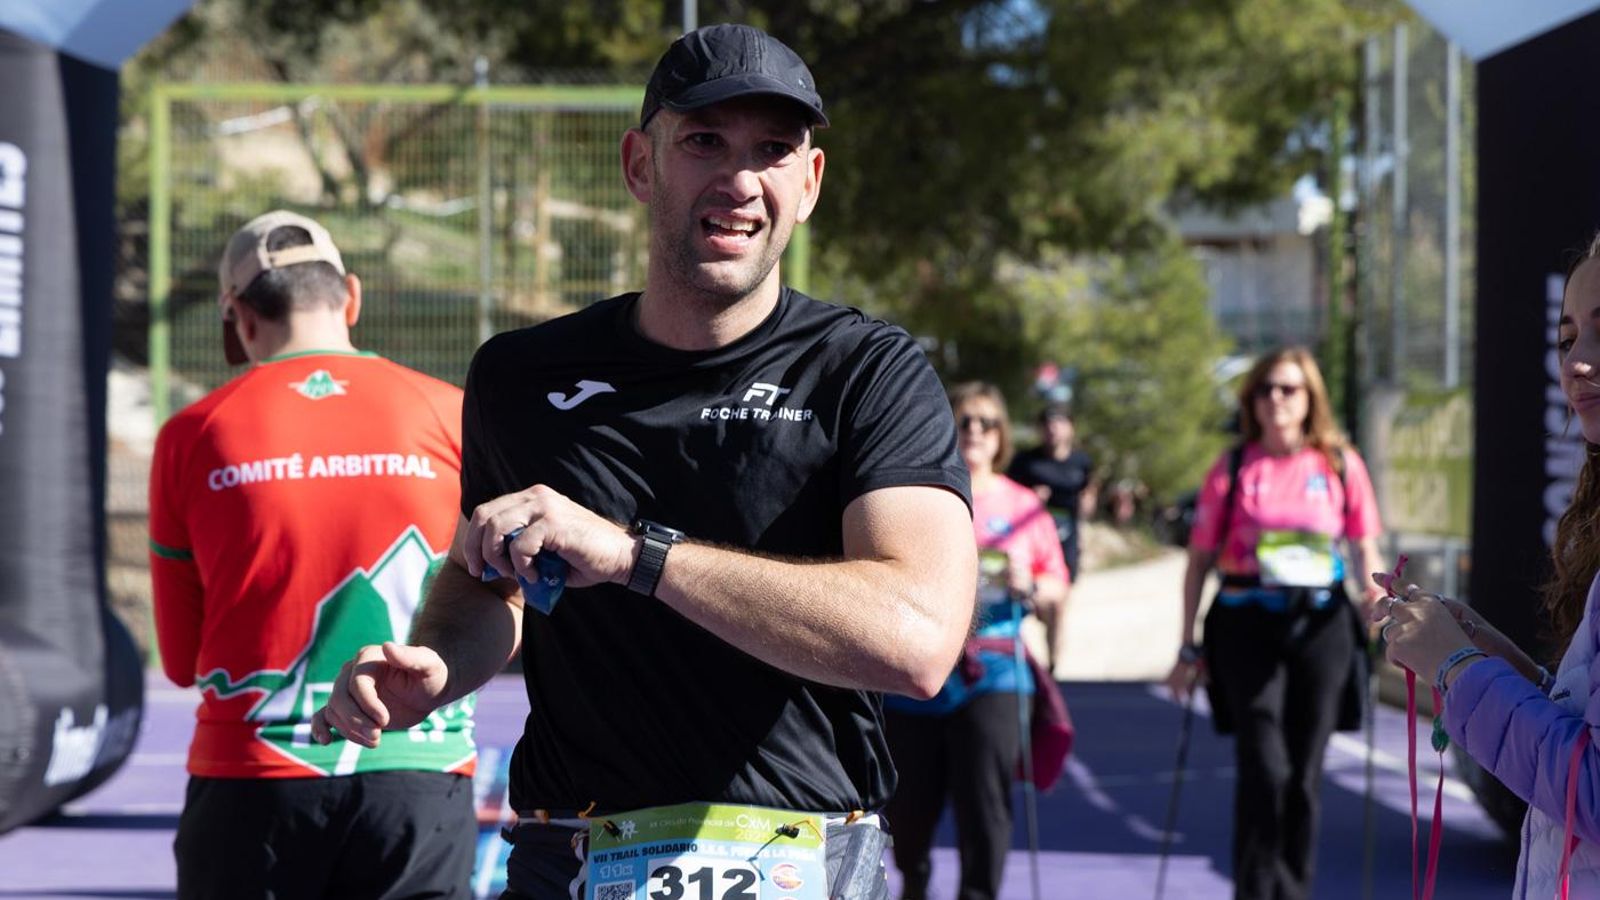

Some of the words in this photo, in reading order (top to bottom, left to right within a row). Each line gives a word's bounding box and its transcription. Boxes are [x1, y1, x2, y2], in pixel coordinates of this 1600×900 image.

[700, 407, 749, 420] FOCHE
[752, 407, 813, 422] TRAINER
[208, 453, 304, 491] COMITÉ
[309, 453, 437, 480] ARBITRAL
[611, 848, 640, 862] TRAIL
[641, 842, 698, 857] SOLIDARIO
[650, 865, 757, 900] 312
